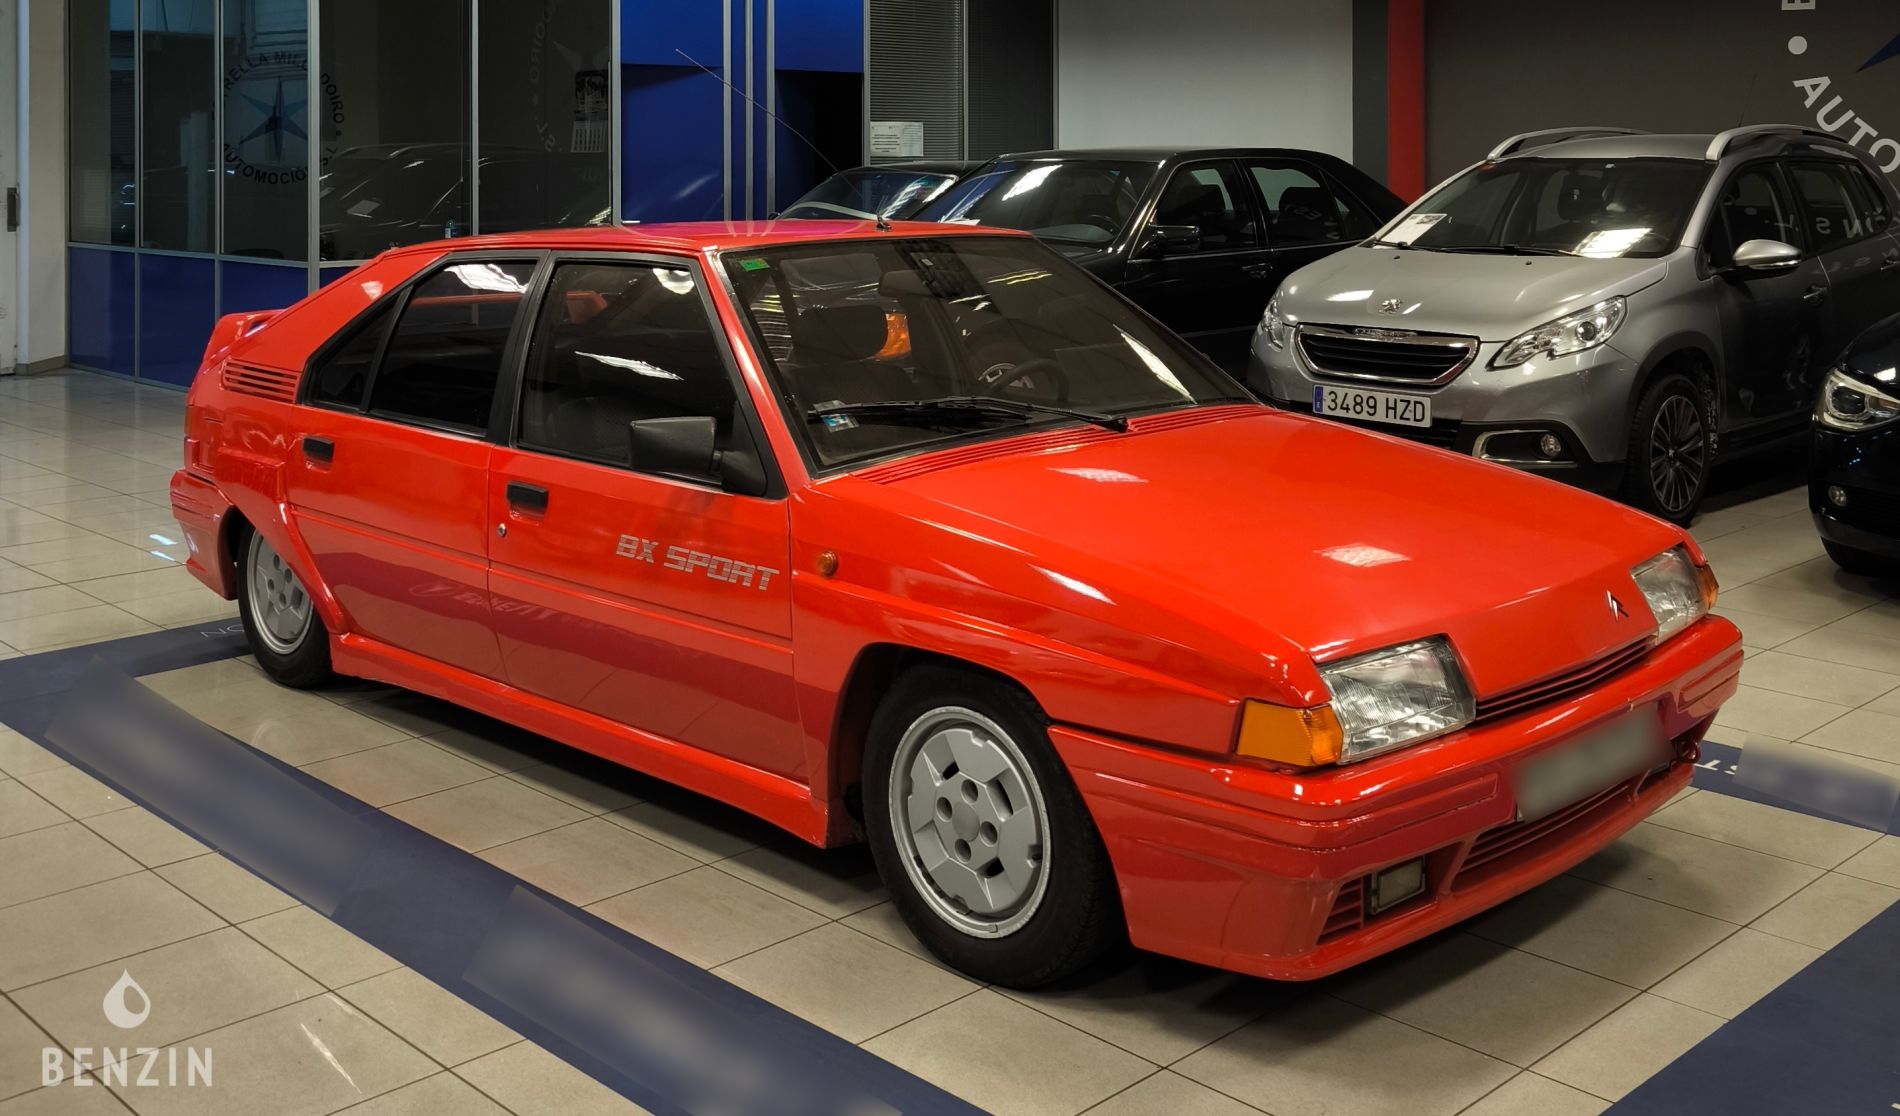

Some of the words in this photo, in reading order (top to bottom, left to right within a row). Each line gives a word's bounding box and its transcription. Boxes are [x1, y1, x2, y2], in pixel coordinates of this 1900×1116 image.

[1327, 391, 1378, 417] 3489
[1385, 397, 1426, 423] HZD
[615, 533, 659, 564] BX
[663, 545, 780, 591] SPORT
